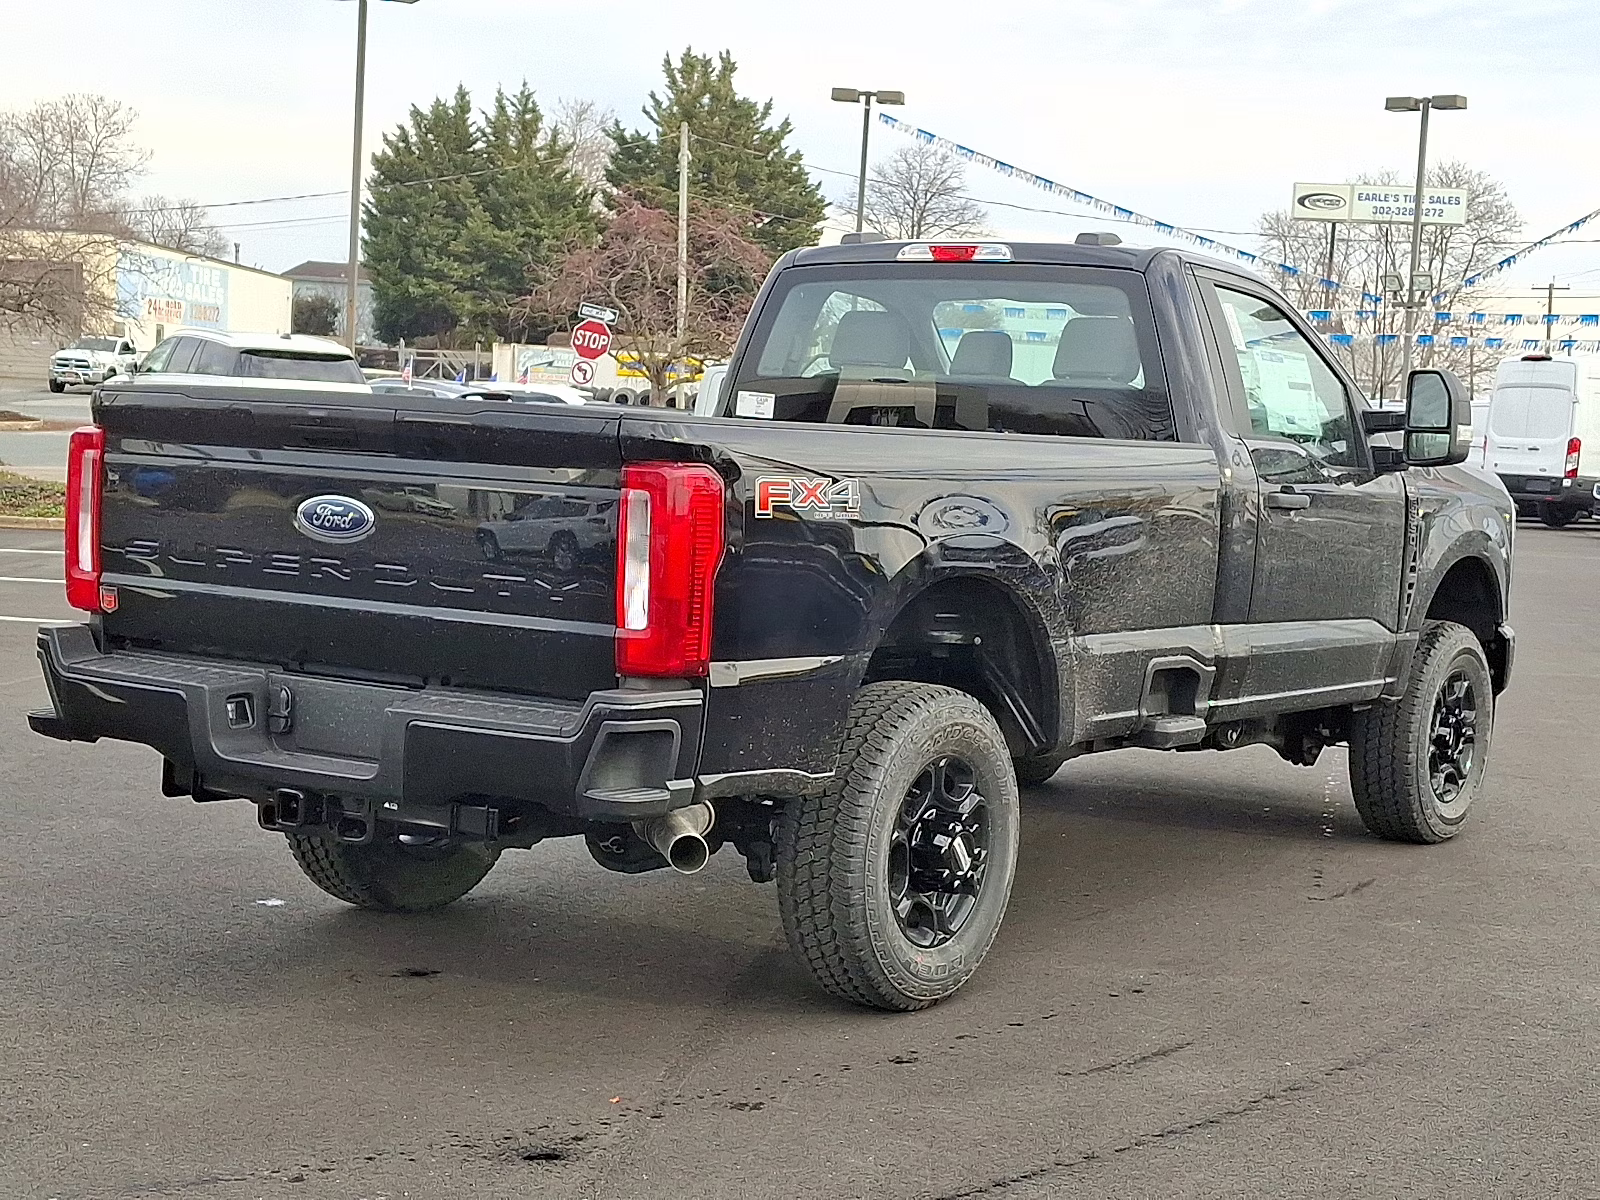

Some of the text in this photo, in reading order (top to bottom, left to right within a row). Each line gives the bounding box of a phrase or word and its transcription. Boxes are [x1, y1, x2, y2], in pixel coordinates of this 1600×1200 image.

[1357, 192, 1400, 203] EARLE'S
[1428, 195, 1461, 206] SALES
[1371, 206, 1444, 218] 302-328272
[189, 263, 221, 287] TIRE
[184, 281, 225, 305] SALES
[574, 329, 609, 350] STOP
[755, 475, 861, 519] FX4
[312, 503, 353, 529] Ford
[123, 540, 580, 601] SUPER DUTY
